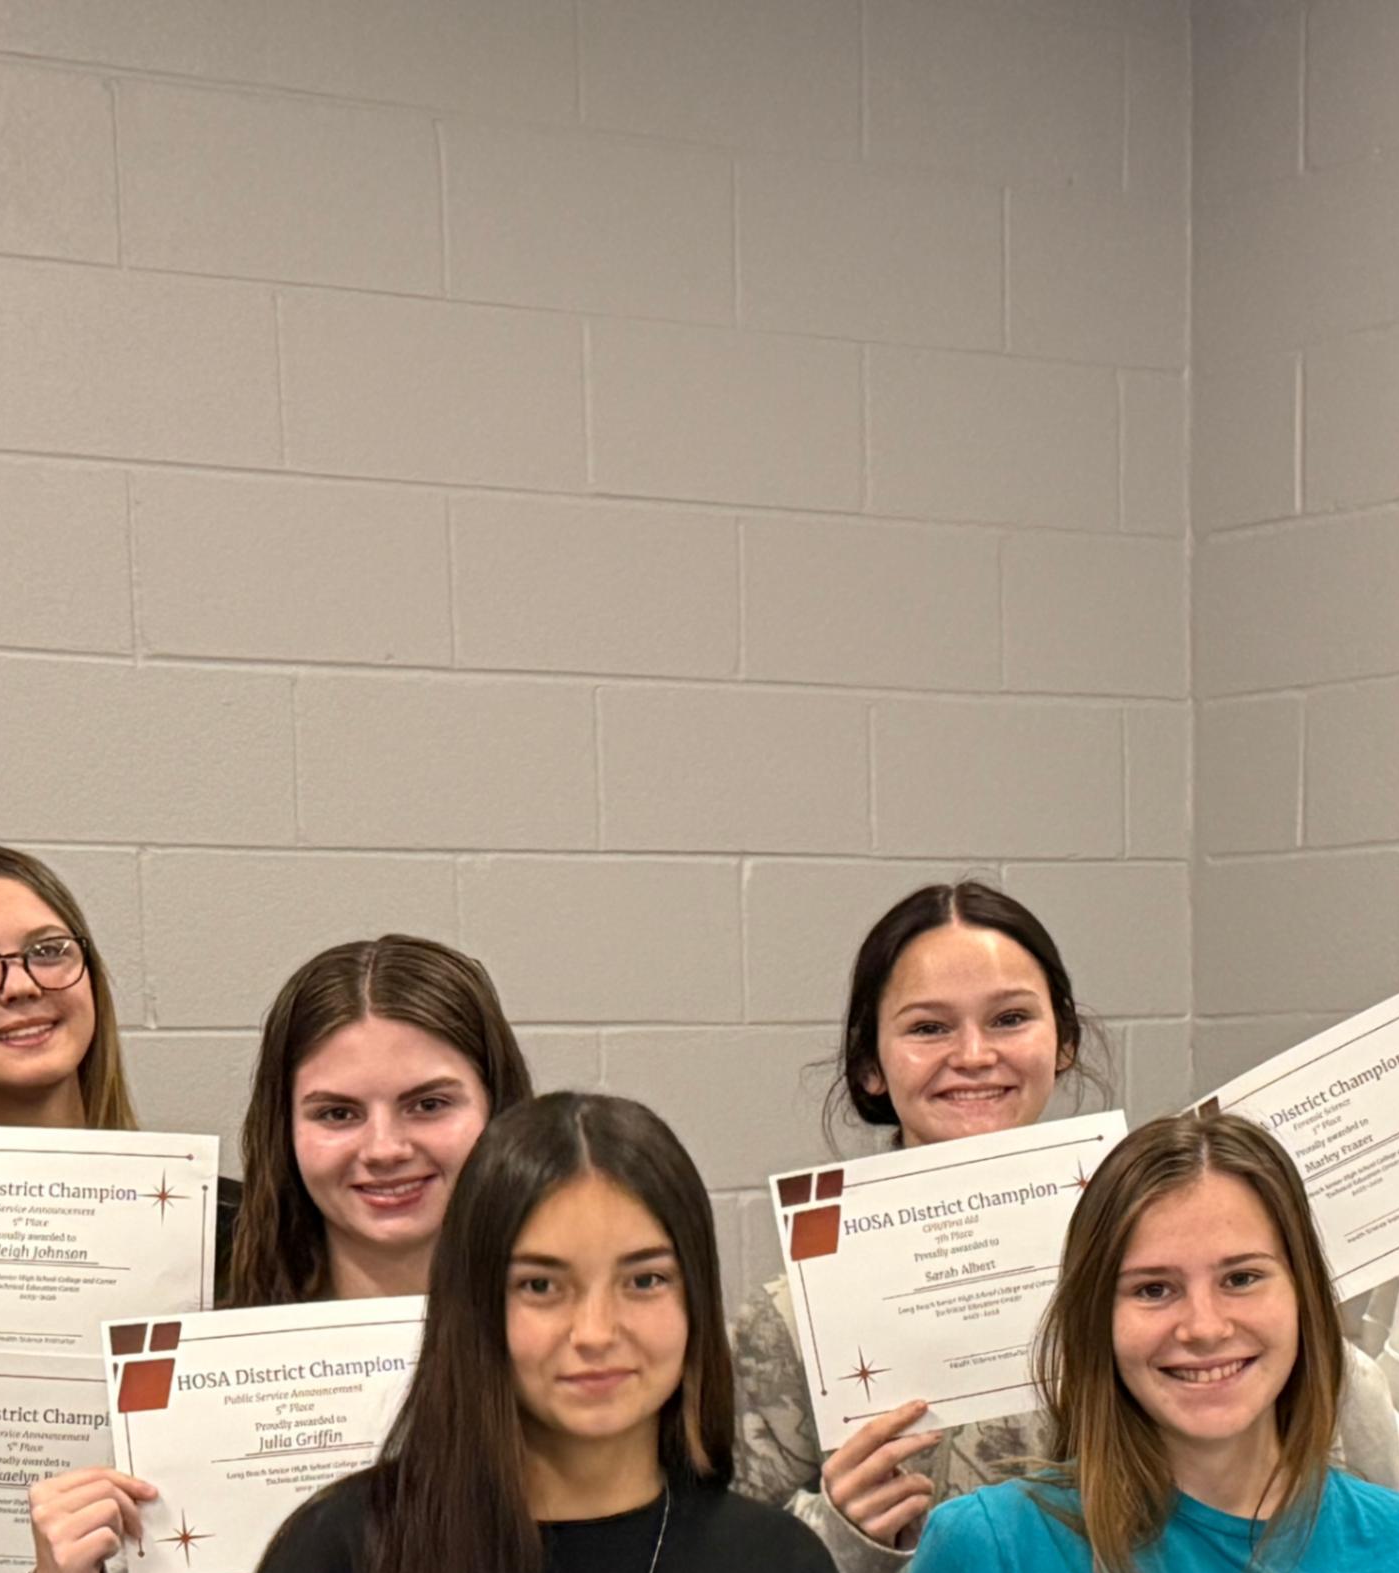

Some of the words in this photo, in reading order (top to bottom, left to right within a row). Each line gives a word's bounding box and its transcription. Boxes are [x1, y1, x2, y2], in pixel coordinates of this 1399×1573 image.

[1270, 1091, 1329, 1128] District
[1305, 1151, 1339, 1173] Marley
[48, 1182, 138, 1204] Champion
[28, 1206, 96, 1216] Announcement
[844, 1212, 895, 1236] HOSA
[898, 1199, 964, 1225] District
[968, 1182, 1058, 1211] Champion
[32, 1245, 88, 1260] Johnson
[925, 1266, 959, 1282] Sarah
[961, 1259, 996, 1275] Albert
[177, 1371, 231, 1391] HOSA
[235, 1364, 305, 1385] District
[309, 1356, 406, 1378] Champion
[224, 1393, 254, 1405] Public
[255, 1391, 289, 1402] Service
[290, 1383, 363, 1399] Announcement
[42, 1408, 110, 1429] Champi
[254, 1419, 292, 1432] Proudly
[293, 1414, 335, 1428] awarded
[336, 1415, 347, 1423] to
[22, 1430, 90, 1442] Announcement
[259, 1434, 292, 1450] Julia
[295, 1429, 343, 1447] Griffin
